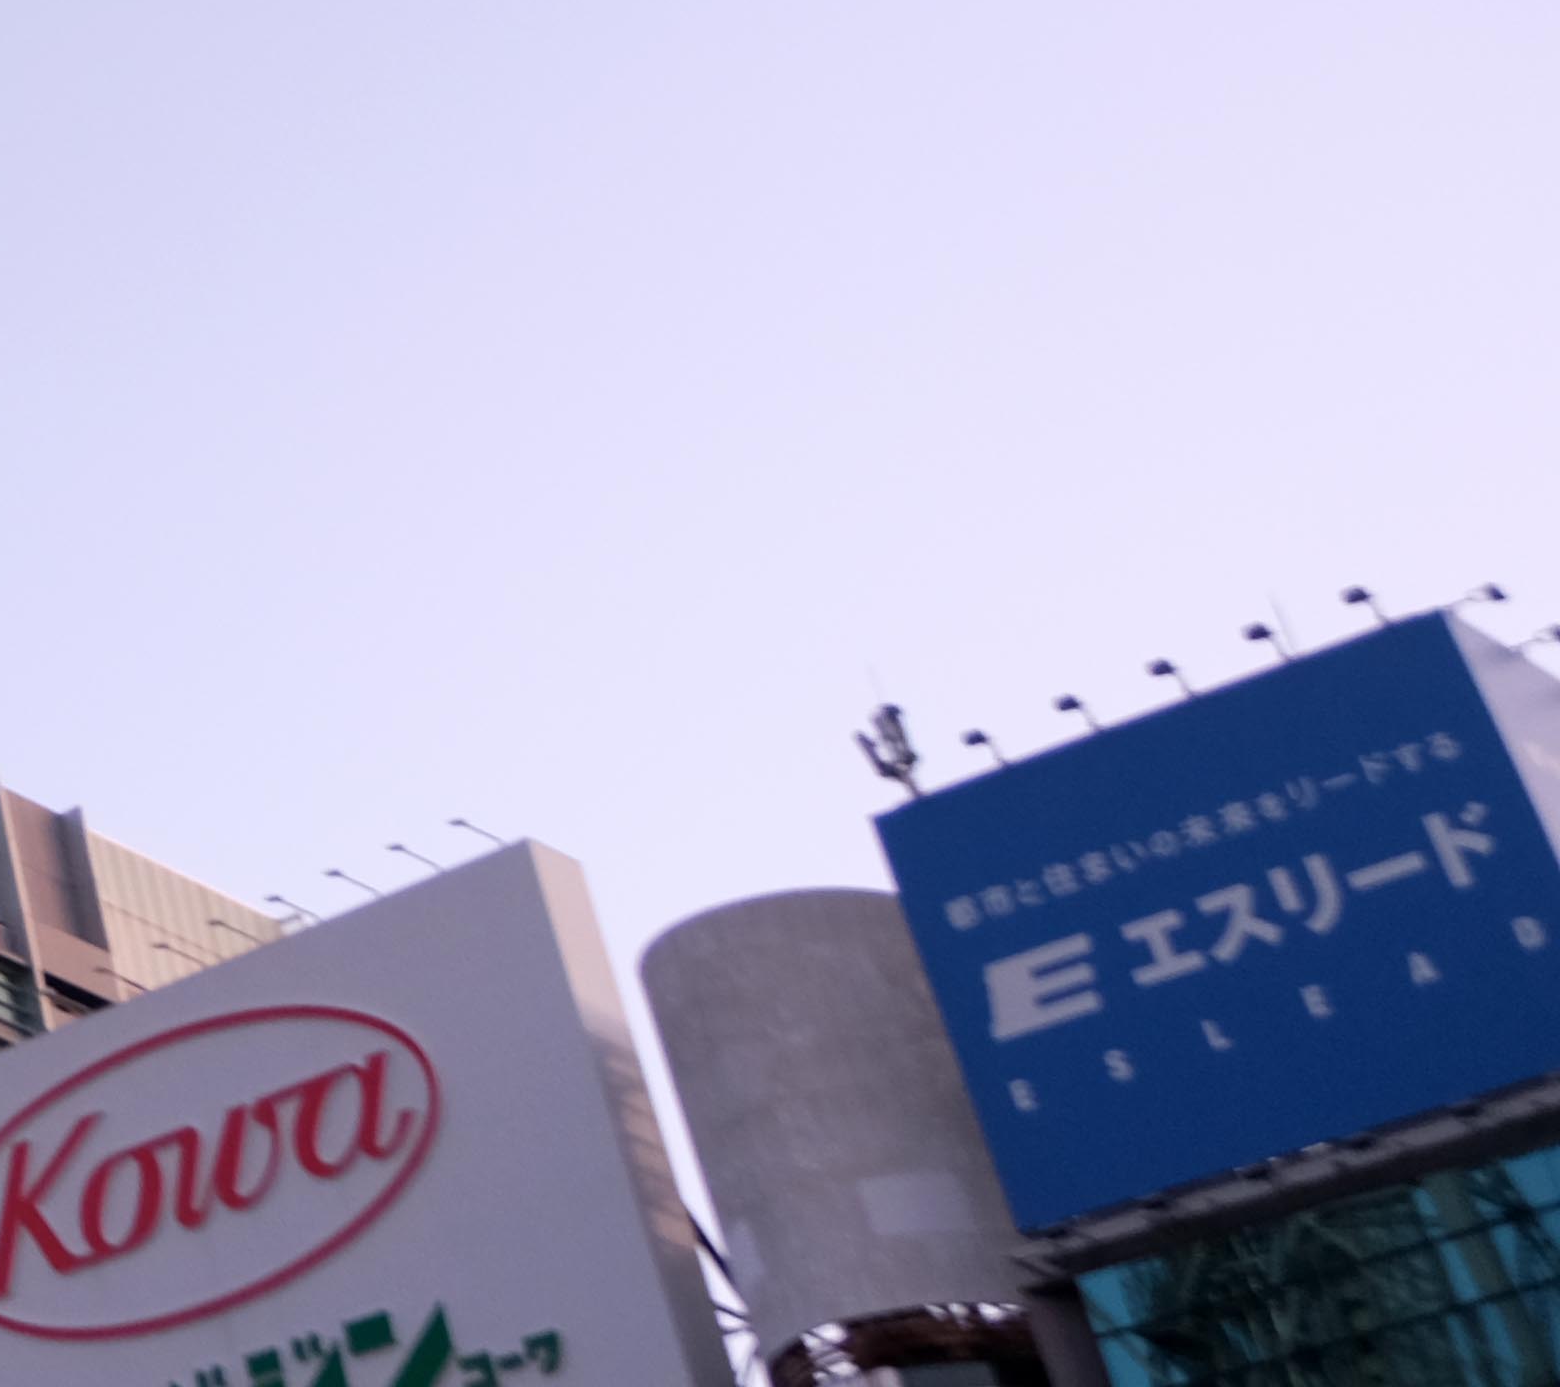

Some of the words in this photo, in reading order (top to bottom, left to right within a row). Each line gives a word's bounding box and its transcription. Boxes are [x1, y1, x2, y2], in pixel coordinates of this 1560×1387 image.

[1120, 801, 1495, 987] エスリード
